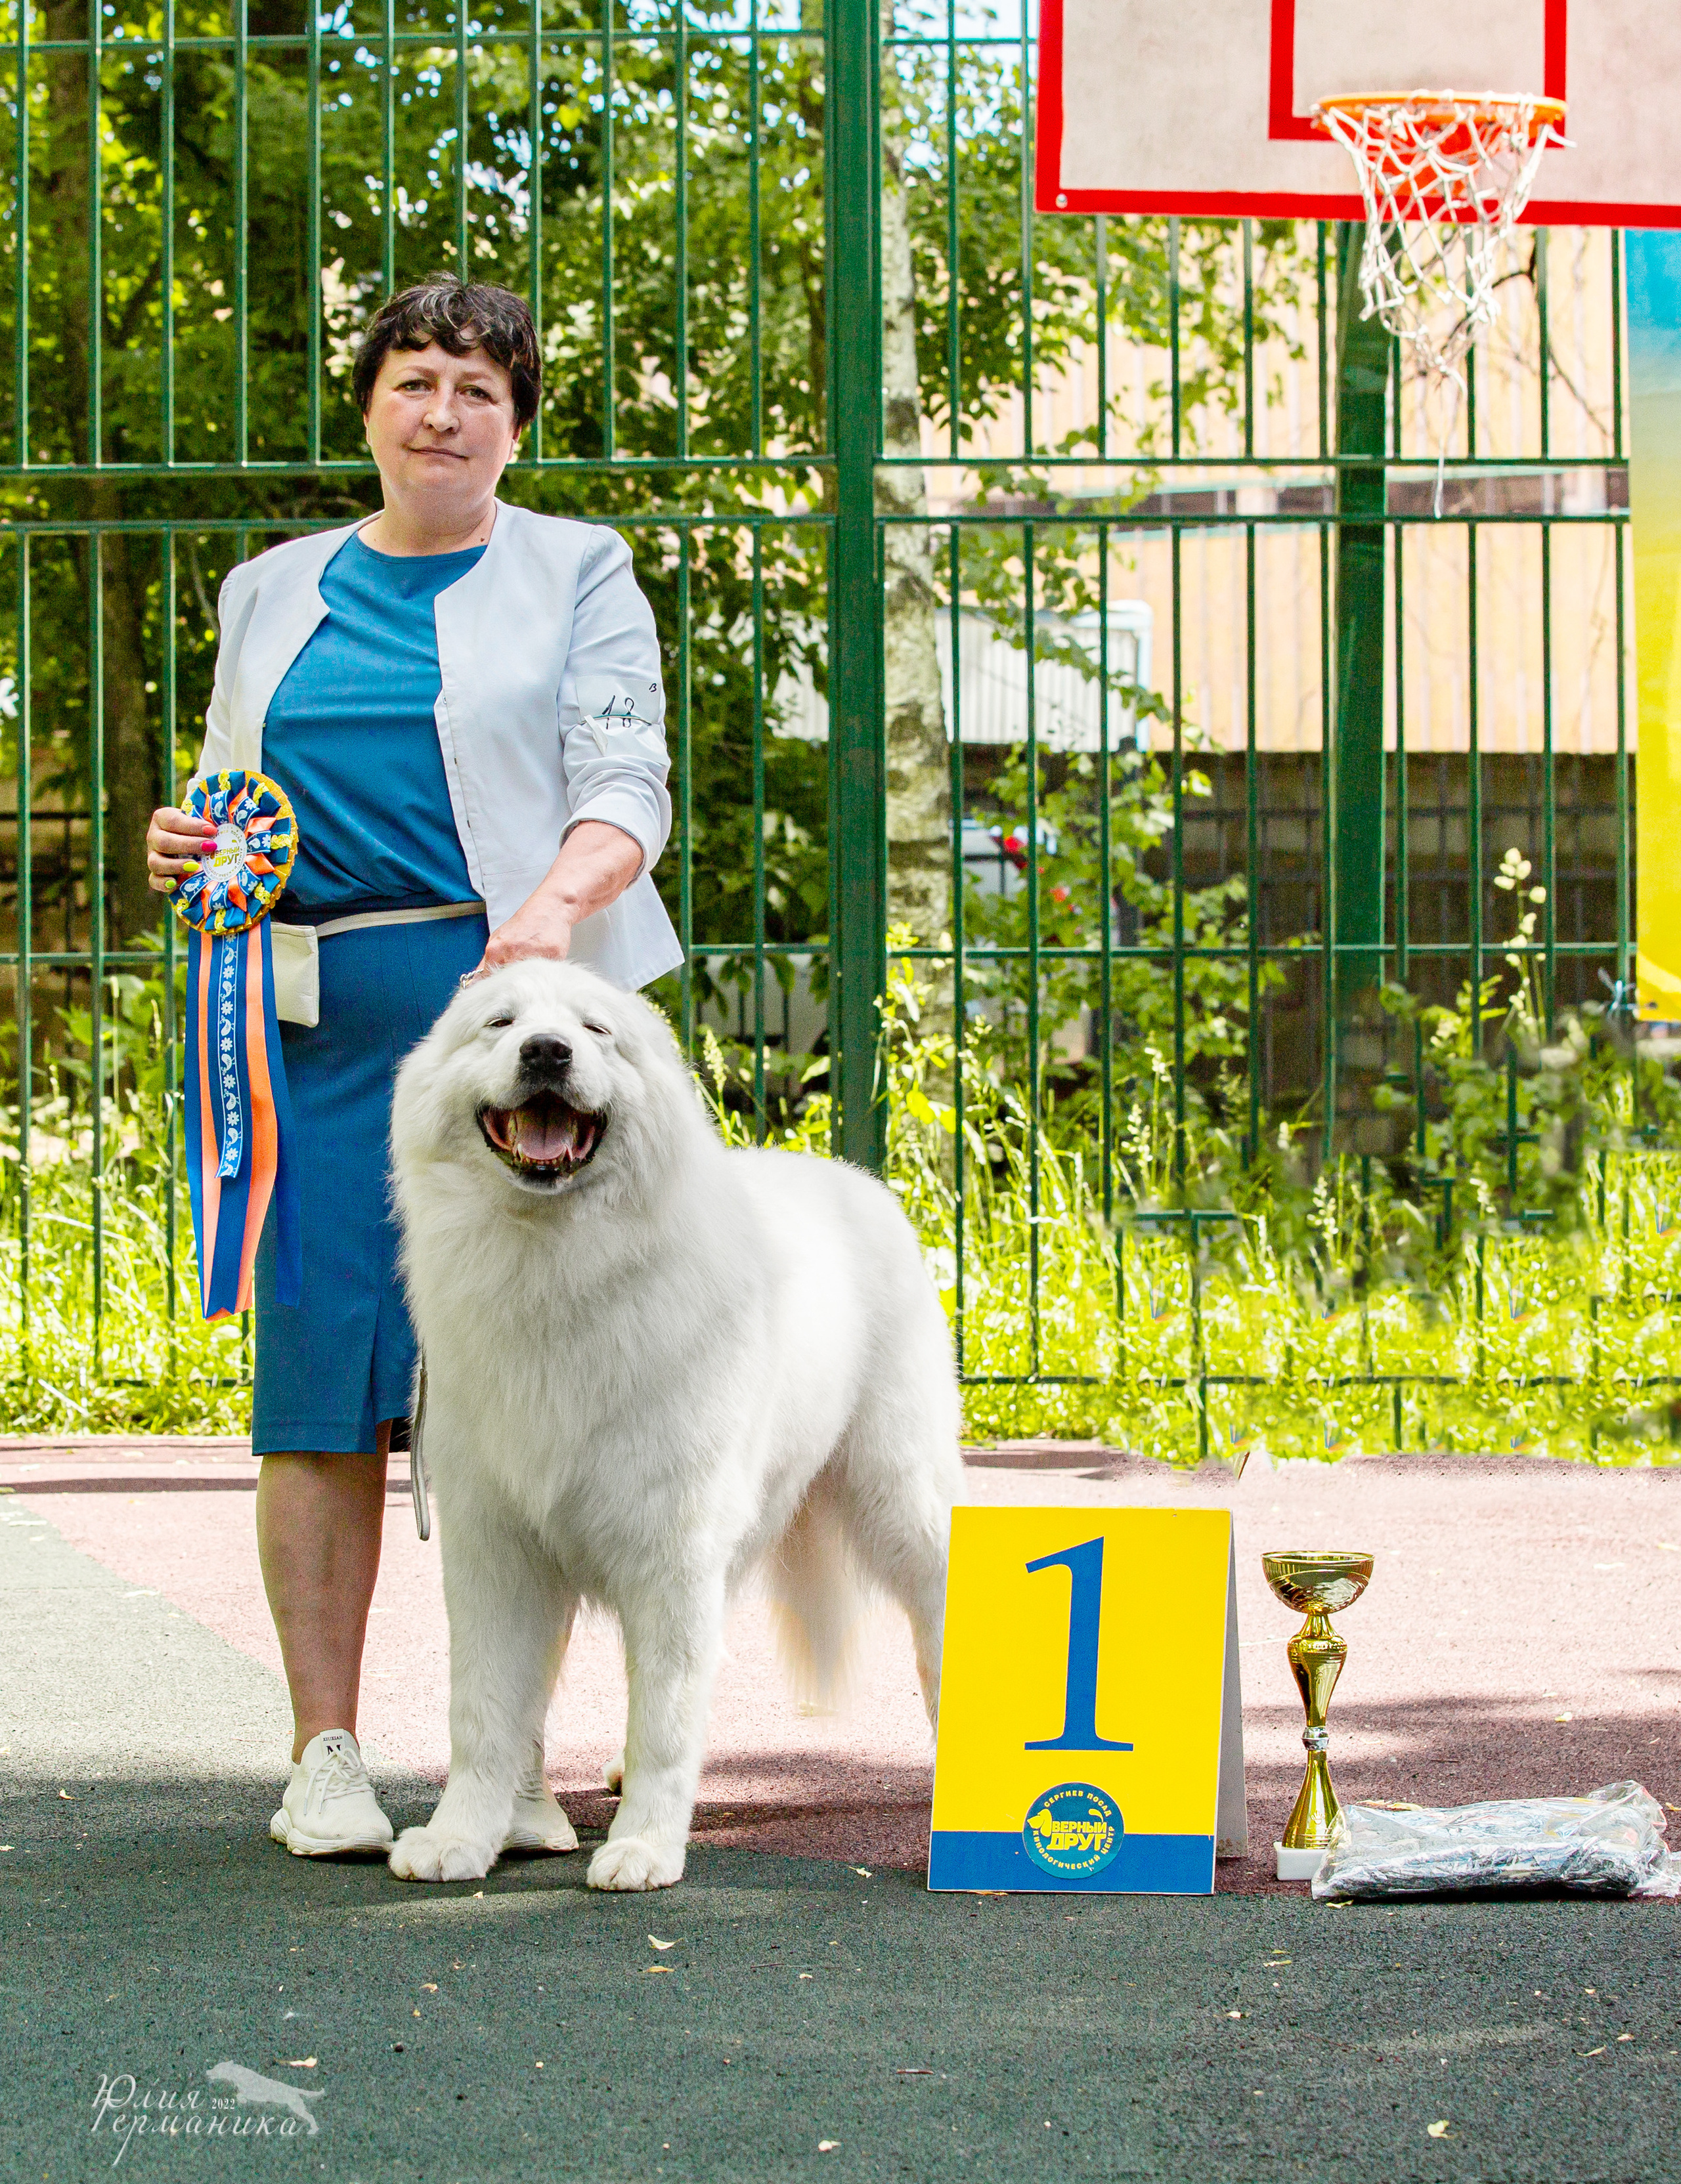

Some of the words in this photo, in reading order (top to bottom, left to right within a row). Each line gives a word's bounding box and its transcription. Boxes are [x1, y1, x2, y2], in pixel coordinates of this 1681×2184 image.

[601, 695, 634, 730] 18
[213, 853, 240, 867] ДРУГ
[1024, 1536, 1133, 1751] 1
[1043, 1790, 1083, 1808] СЕРГИЕВ
[1087, 1793, 1112, 1817] ПОСАД
[1033, 1830, 1101, 1870] КИНОЛОГИЧЕСКИЙ
[1100, 1826, 1114, 1854] ЦЕНТР
[1046, 1832, 1107, 1851] ДРУГ
